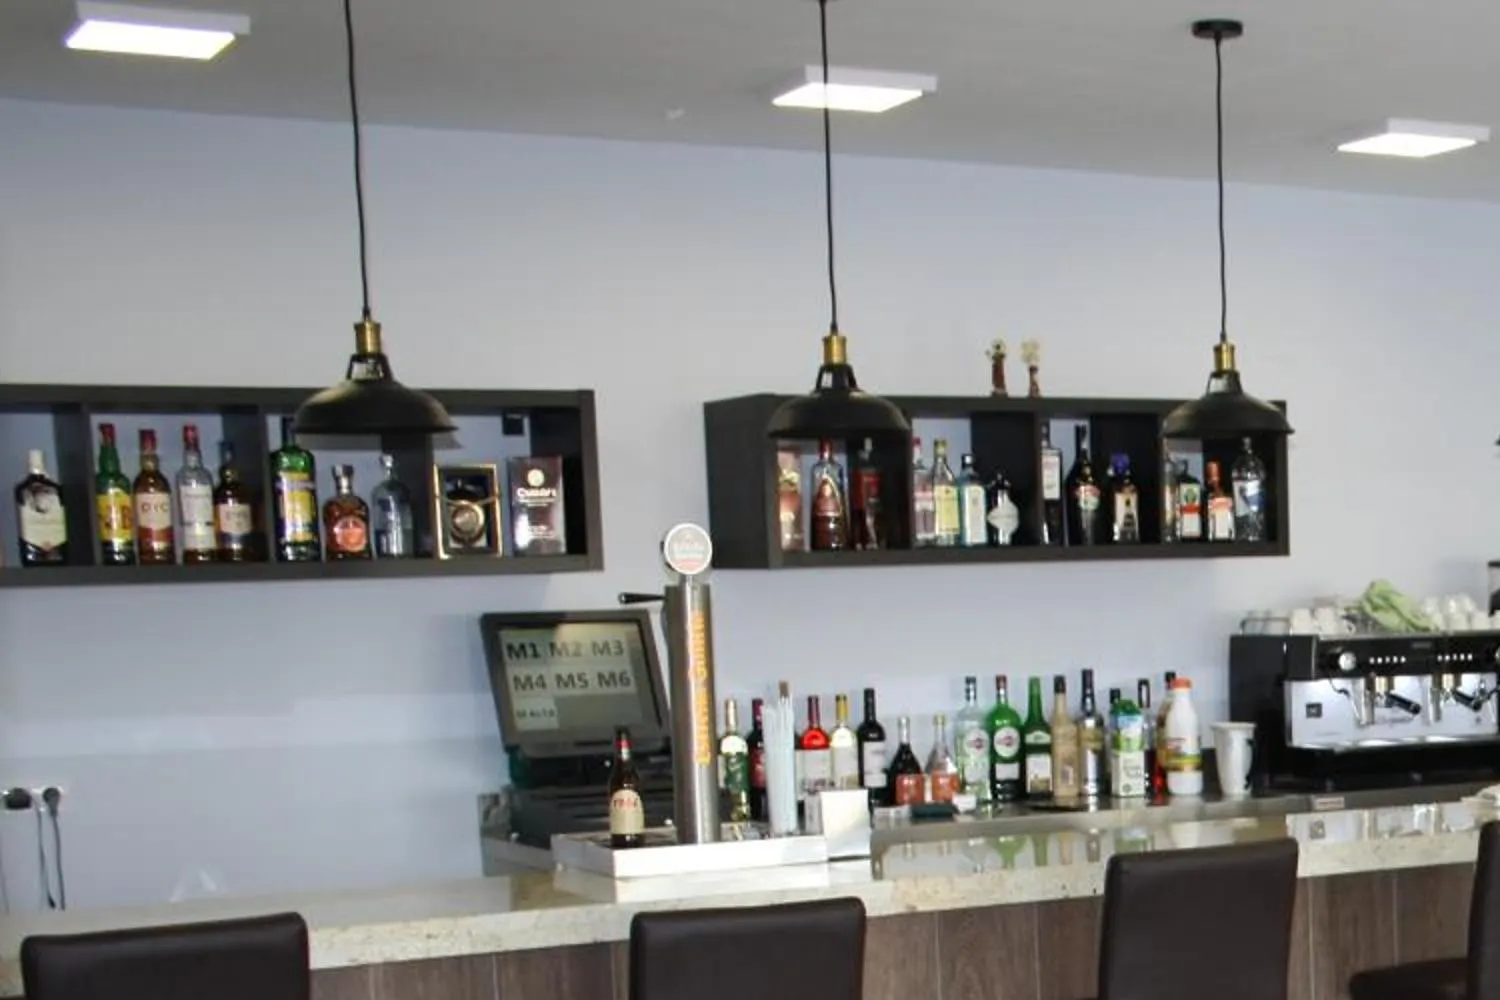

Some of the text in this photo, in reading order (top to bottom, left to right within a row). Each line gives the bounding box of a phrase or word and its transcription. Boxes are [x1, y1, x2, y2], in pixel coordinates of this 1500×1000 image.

[506, 640, 625, 660] M1 M2 M3
[513, 672, 631, 691] M4 M5 M6
